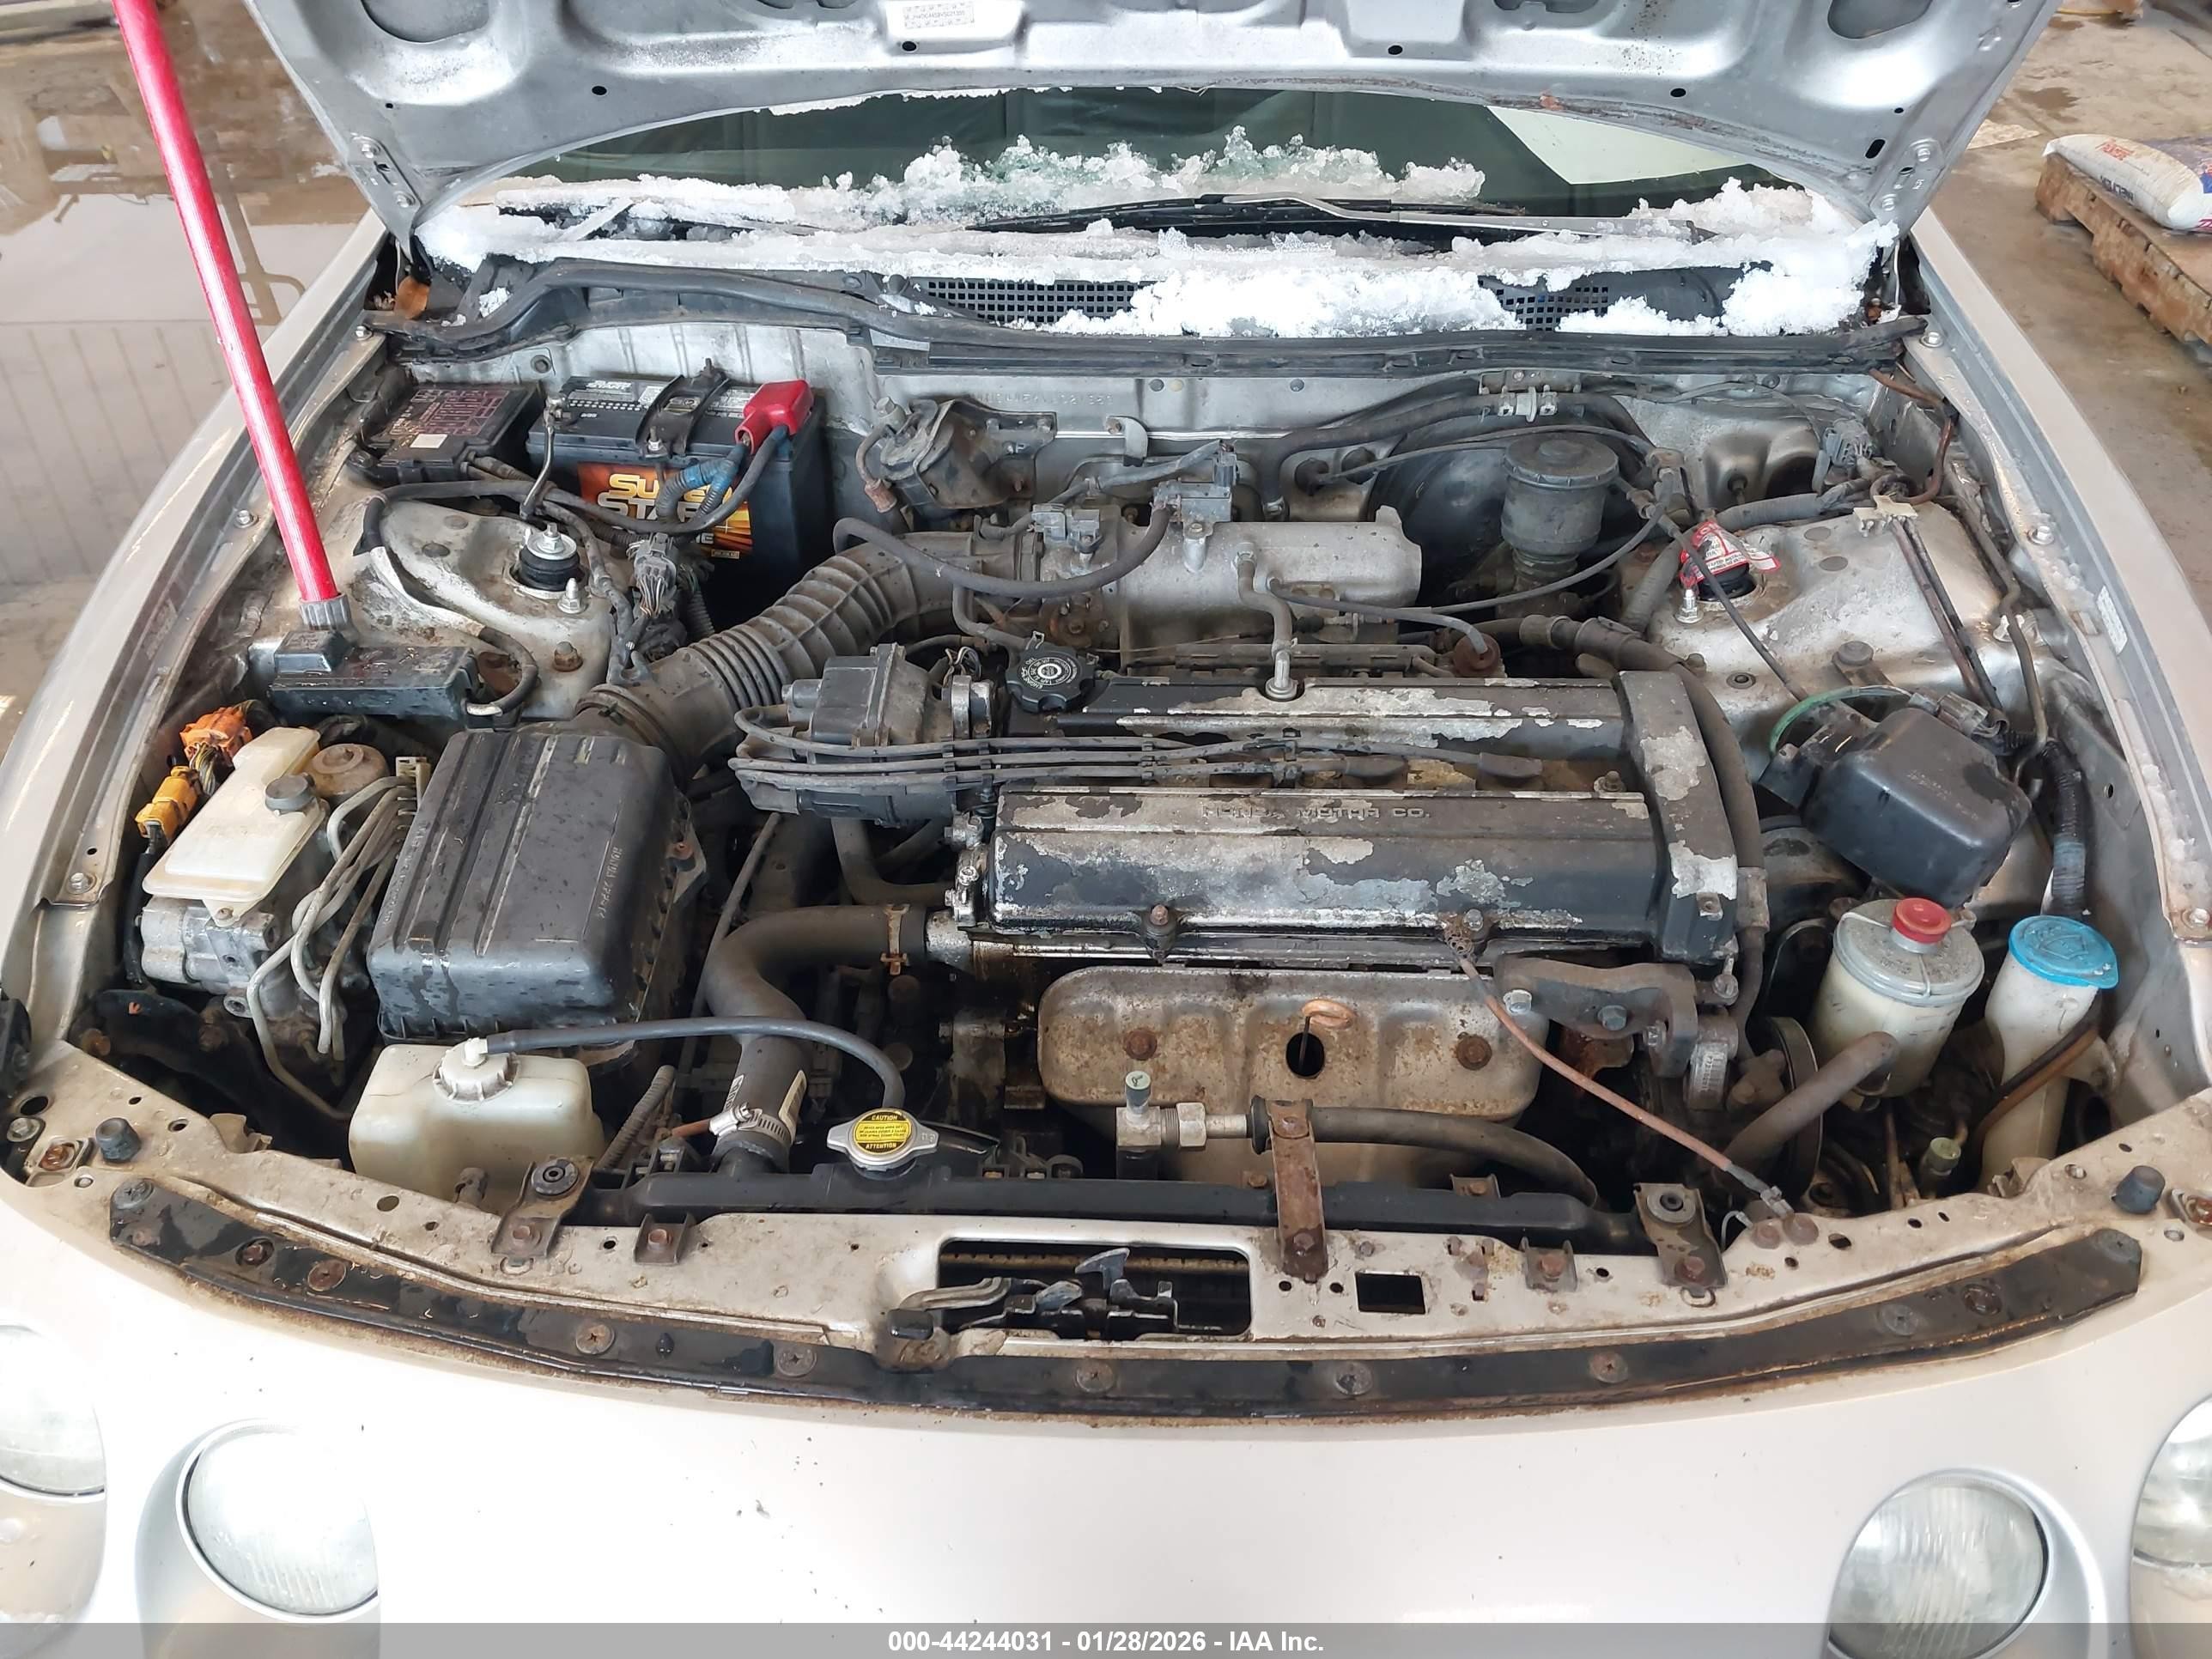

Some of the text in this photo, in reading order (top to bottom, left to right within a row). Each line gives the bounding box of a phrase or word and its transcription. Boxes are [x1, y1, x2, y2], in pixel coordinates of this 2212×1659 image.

[609, 474, 733, 507] SUE
[597, 492, 704, 523] STR
[1297, 807, 1380, 819] MOTOR
[1391, 807, 1431, 817] CO.
